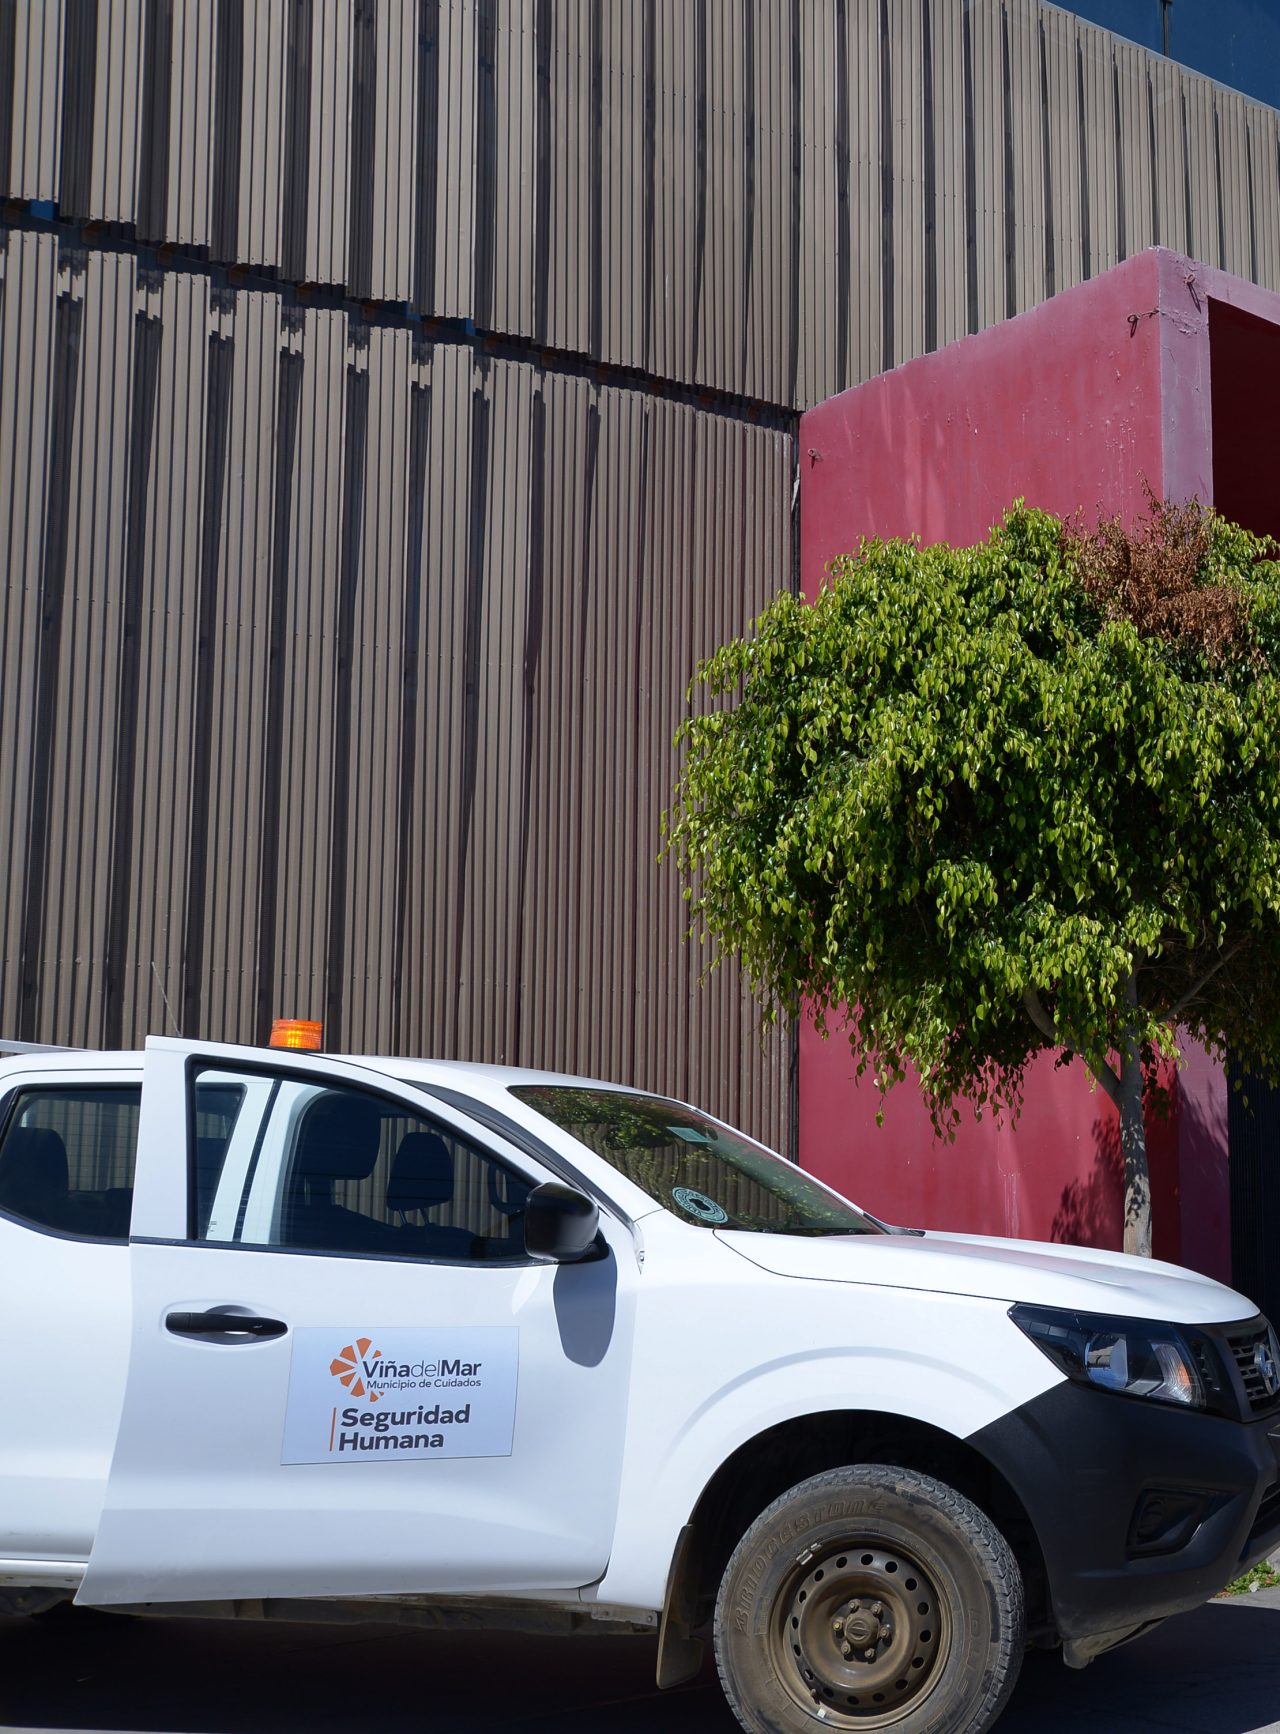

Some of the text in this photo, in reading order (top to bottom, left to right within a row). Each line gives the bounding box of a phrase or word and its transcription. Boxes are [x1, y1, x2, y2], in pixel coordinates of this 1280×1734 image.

[366, 1378, 482, 1391] Municipio de Cuidados
[341, 1403, 471, 1432] Seguridad
[339, 1432, 445, 1452] Humana
